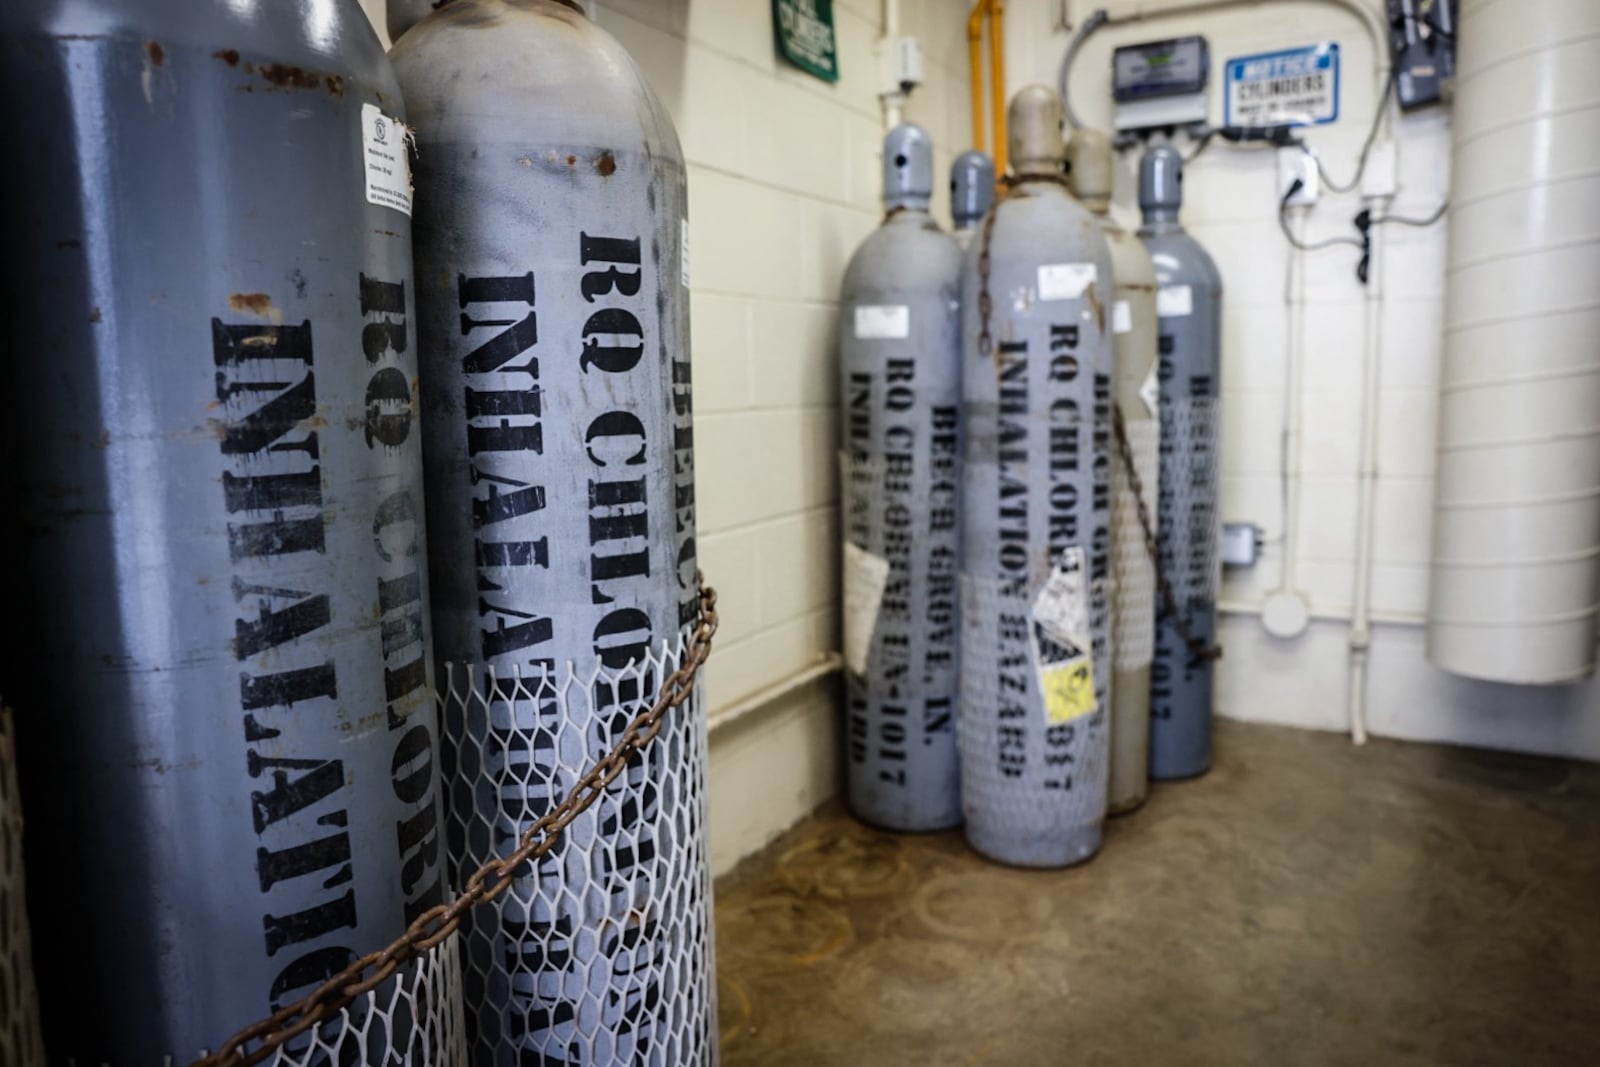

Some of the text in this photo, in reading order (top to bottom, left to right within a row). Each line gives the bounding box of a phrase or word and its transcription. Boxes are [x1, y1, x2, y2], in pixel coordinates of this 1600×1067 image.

[359, 272, 413, 449] RQ
[579, 231, 644, 374] RQ
[1048, 324, 1080, 383] RQ
[885, 358, 915, 413] RQ
[928, 406, 958, 532] BEECH
[998, 340, 1029, 598] INHALATION
